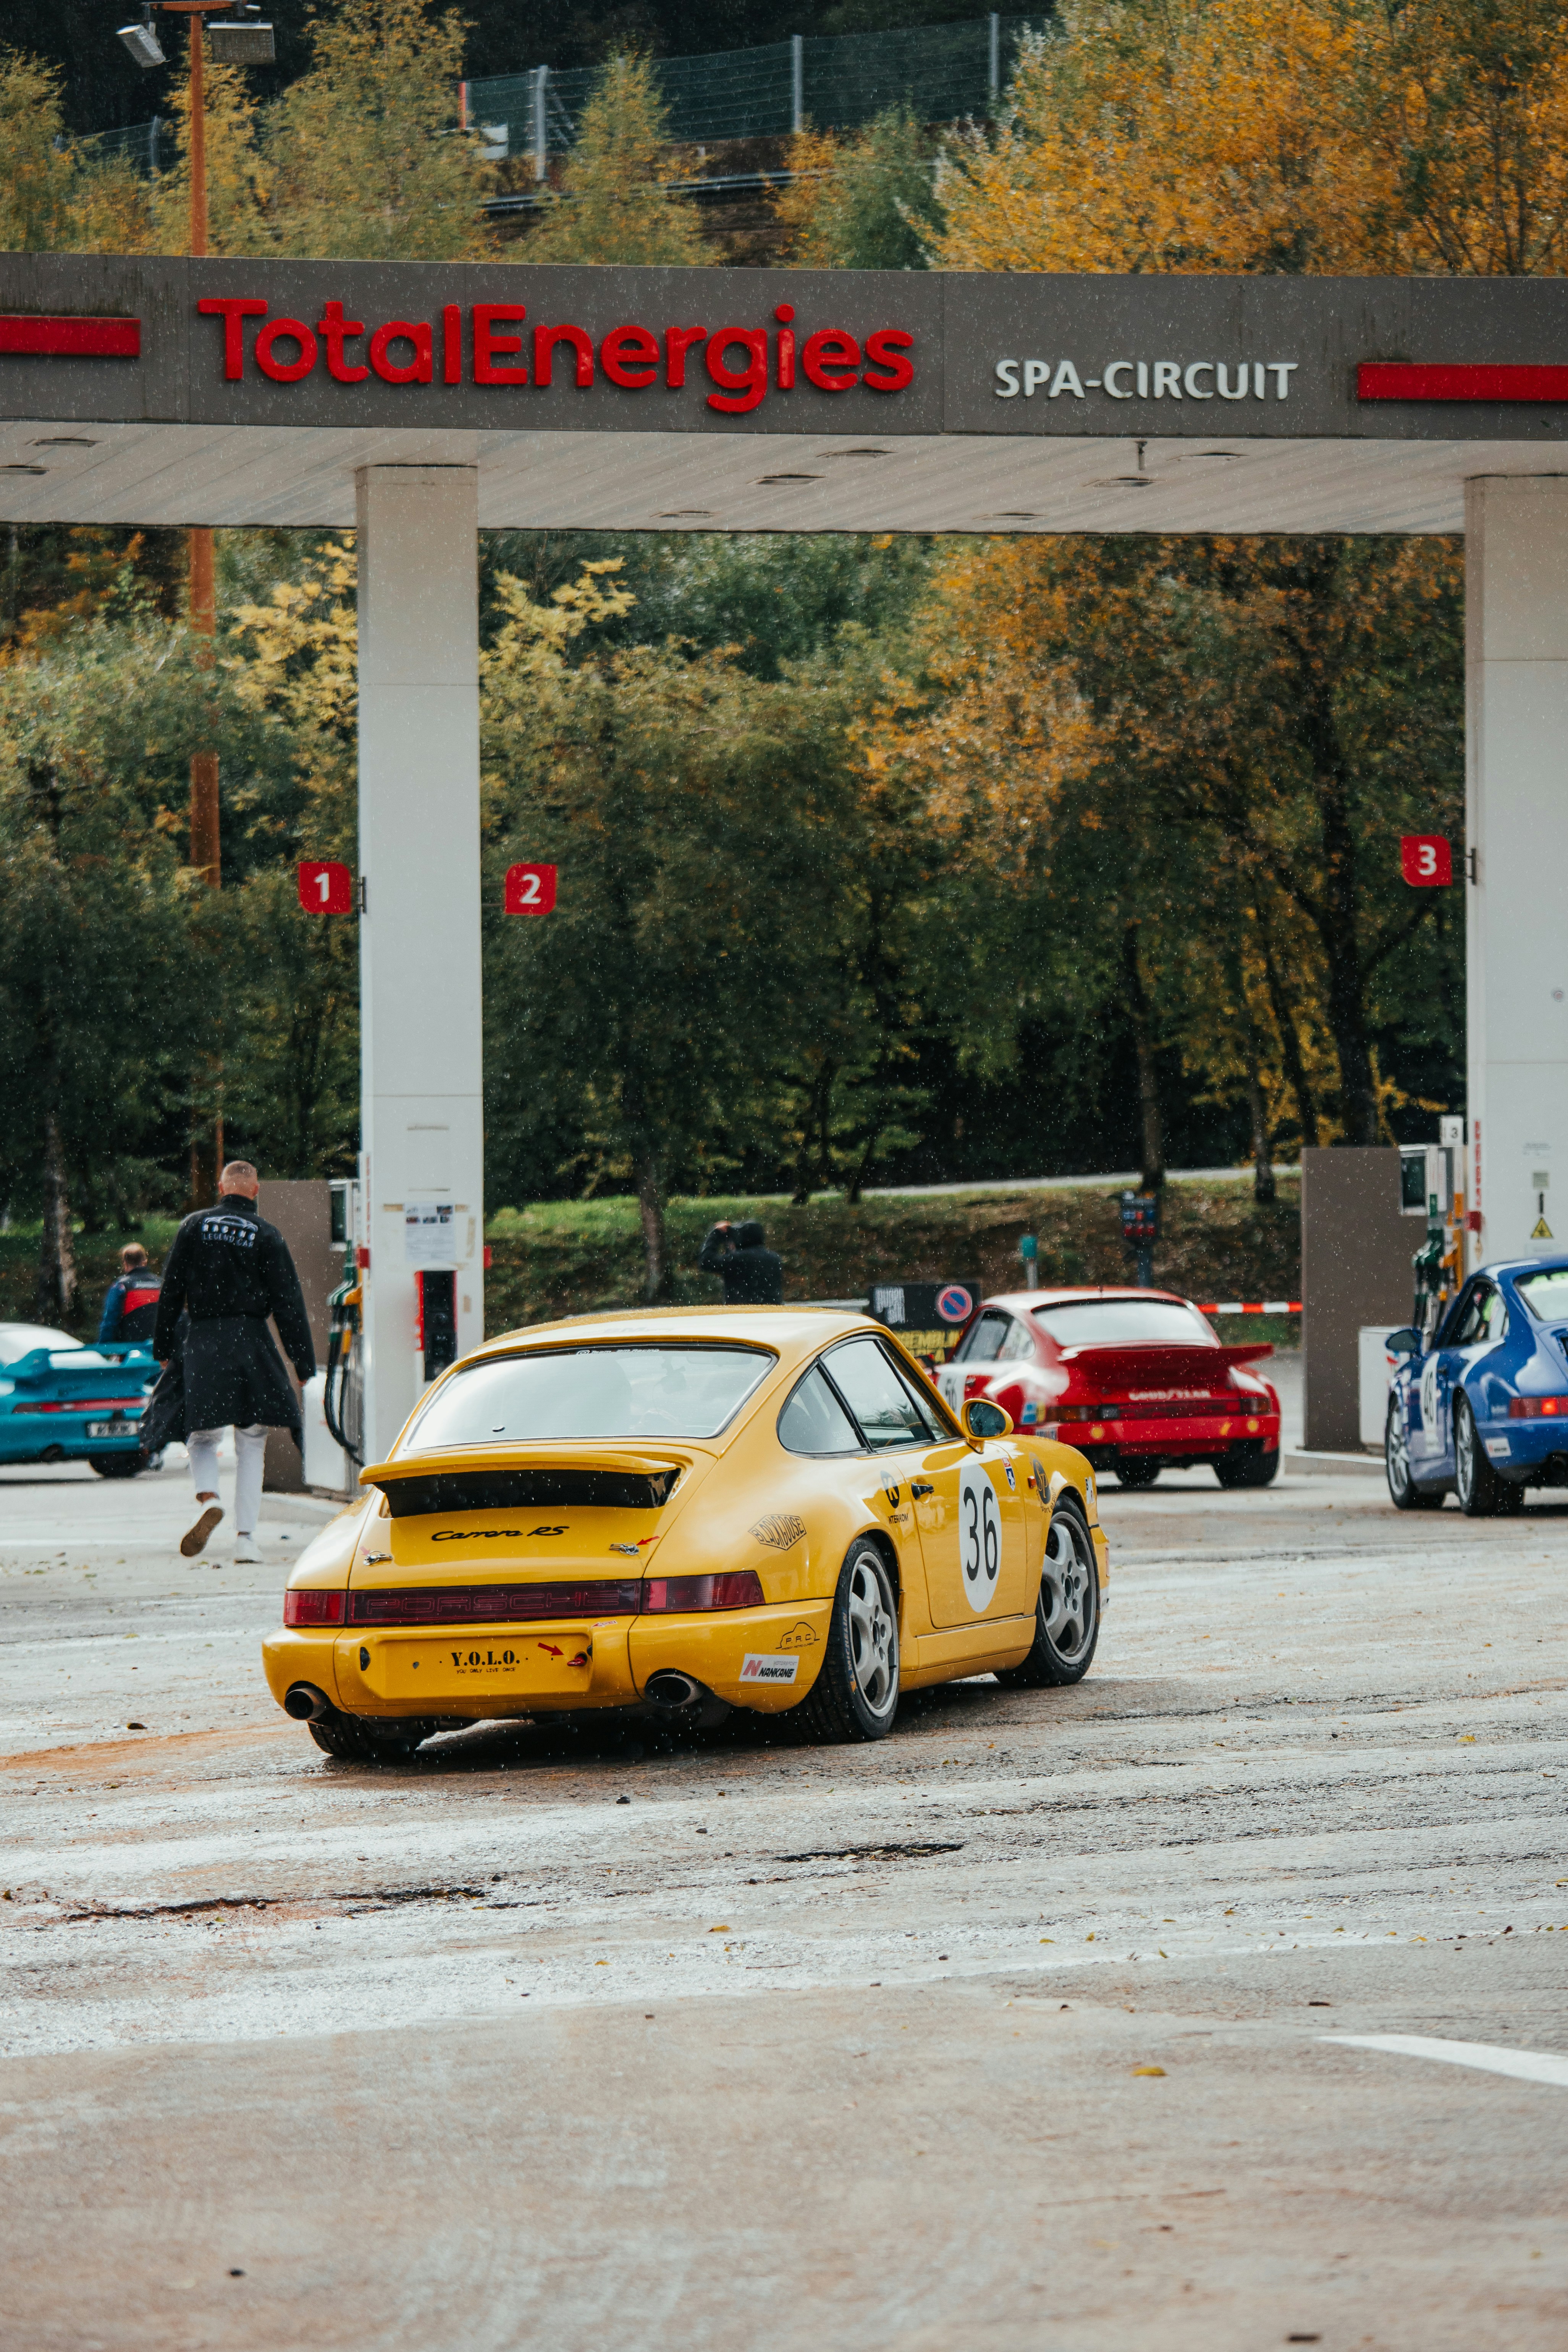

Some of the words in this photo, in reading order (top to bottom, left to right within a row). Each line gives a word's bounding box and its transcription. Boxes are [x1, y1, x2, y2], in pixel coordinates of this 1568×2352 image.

[197, 298, 915, 413] TotalEnergies
[995, 359, 1298, 400] SPA-CIRCUIT
[1418, 844, 1437, 876] 3
[314, 872, 330, 903] 1
[519, 873, 542, 904] 2
[432, 1531, 523, 1541] Carrera
[527, 1526, 570, 1536] RS
[963, 1486, 997, 1581] 36
[367, 1590, 619, 1615] PORSCHE
[842, 1612, 853, 1671] MICHELIN
[451, 1650, 520, 1666] Y.O.L.O.
[758, 1667, 795, 1678] NANKANG
